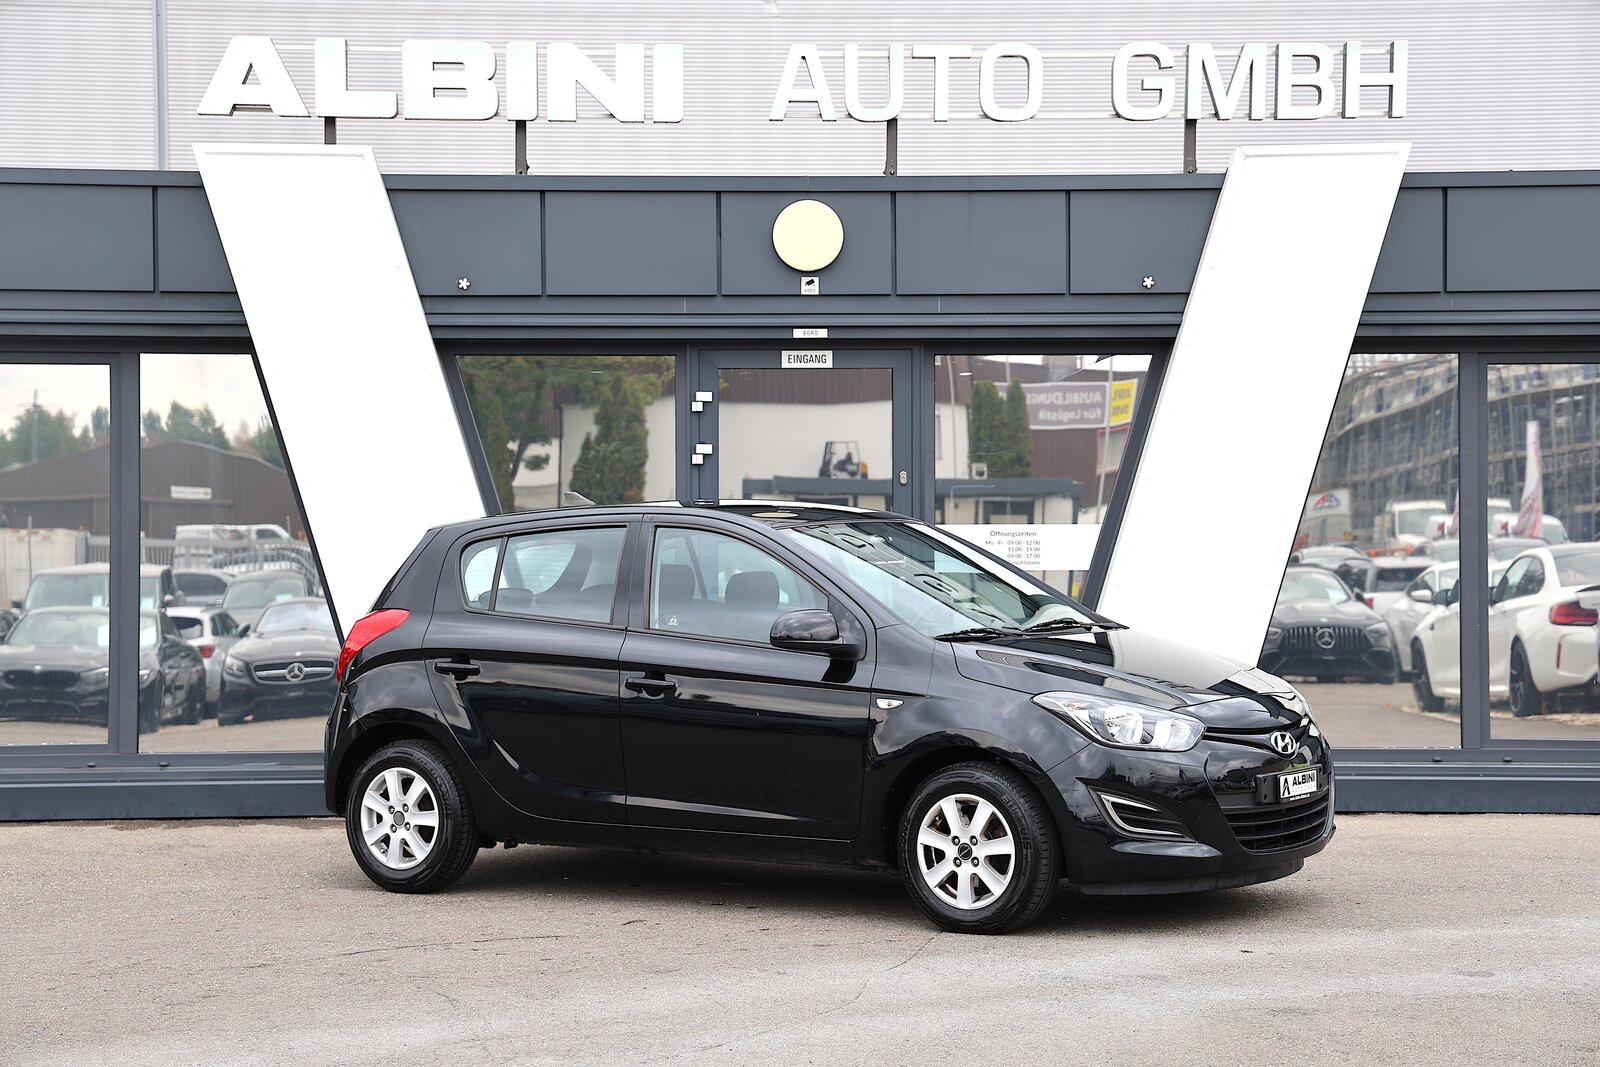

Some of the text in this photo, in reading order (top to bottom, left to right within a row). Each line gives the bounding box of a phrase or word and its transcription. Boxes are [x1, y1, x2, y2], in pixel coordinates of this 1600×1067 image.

[197, 35, 1409, 123] ALBINI AUTO GMBH
[787, 354, 827, 364] EINGANG
[1292, 772, 1315, 787] ALBINI
